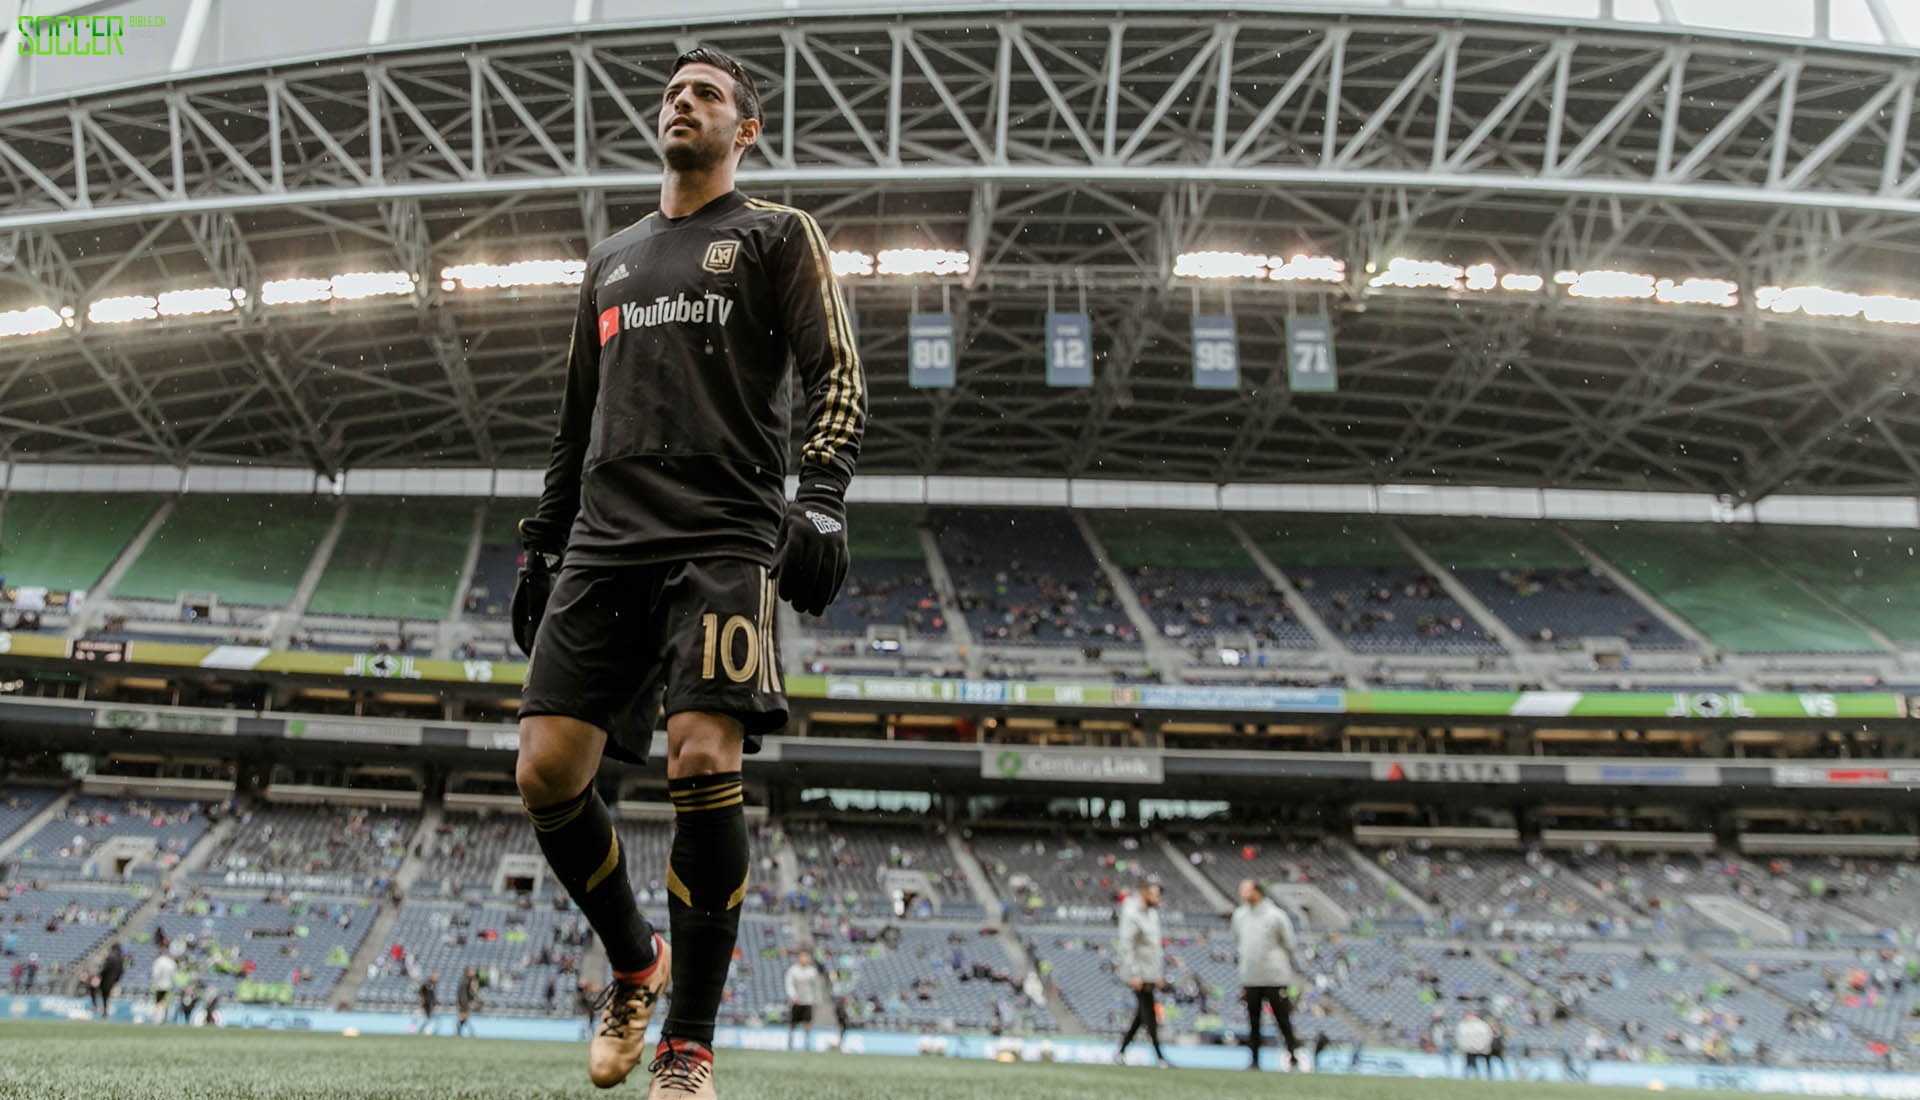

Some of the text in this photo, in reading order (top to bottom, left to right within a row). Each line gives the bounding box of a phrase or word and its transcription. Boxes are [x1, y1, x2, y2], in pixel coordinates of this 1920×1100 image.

[912, 339, 950, 369] 80
[1053, 338, 1086, 368] 12
[1196, 340, 1236, 371] 96
[1294, 342, 1330, 373] 71
[702, 613, 759, 682] 10
[463, 660, 493, 683] VS
[1799, 693, 1839, 717] VS
